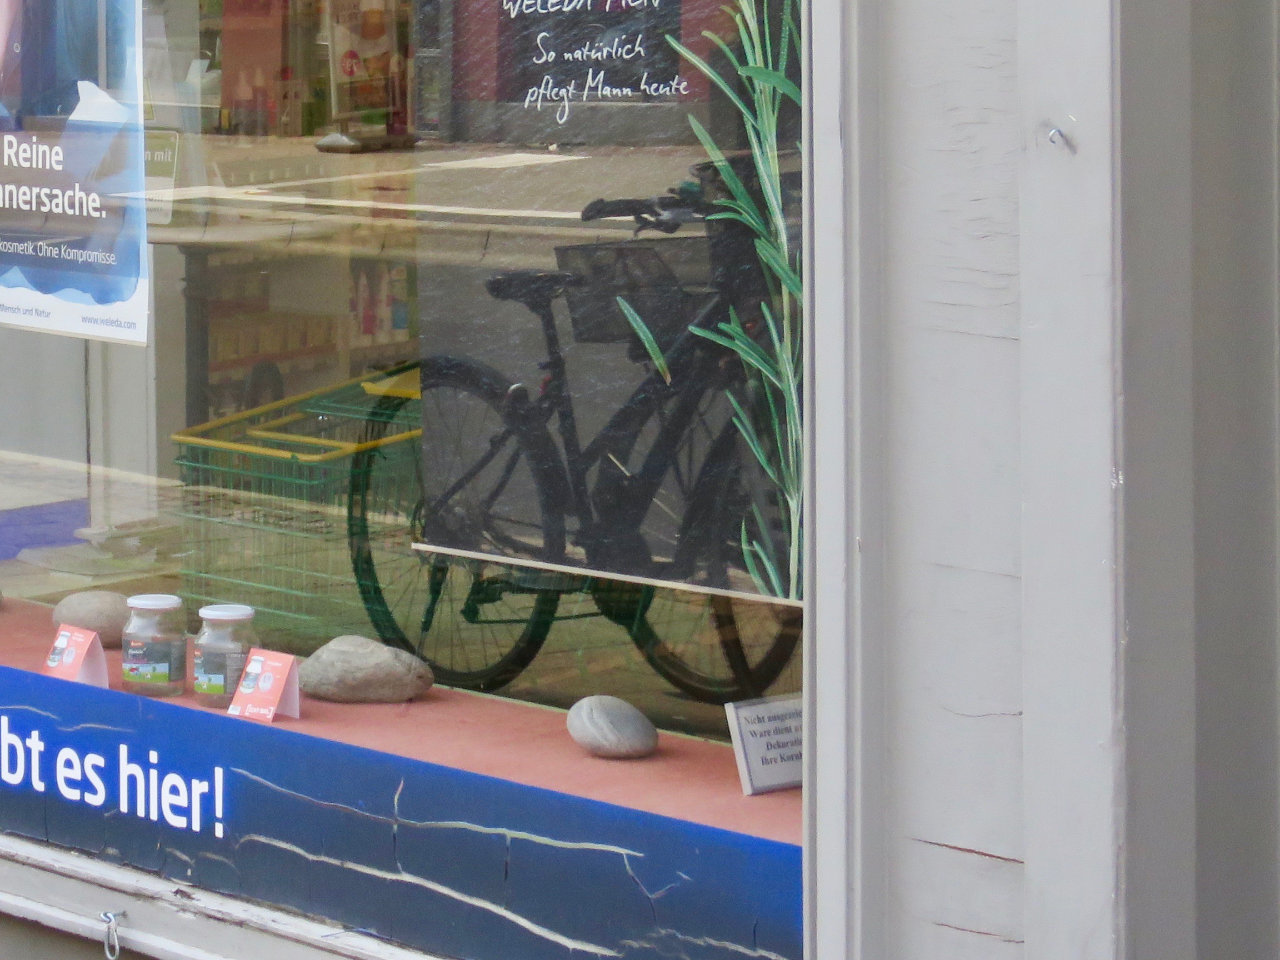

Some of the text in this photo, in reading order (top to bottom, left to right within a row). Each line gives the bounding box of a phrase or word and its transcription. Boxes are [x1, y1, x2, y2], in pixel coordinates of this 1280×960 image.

[533, 32, 645, 64] So natürlich
[524, 68, 689, 124] pflegt Mann heute
[3, 134, 64, 171] Reine
[37, 242, 59, 258] Ohne
[61, 245, 118, 265] Kompromisse.
[56, 747, 107, 807] es
[119, 743, 224, 839] hier!
